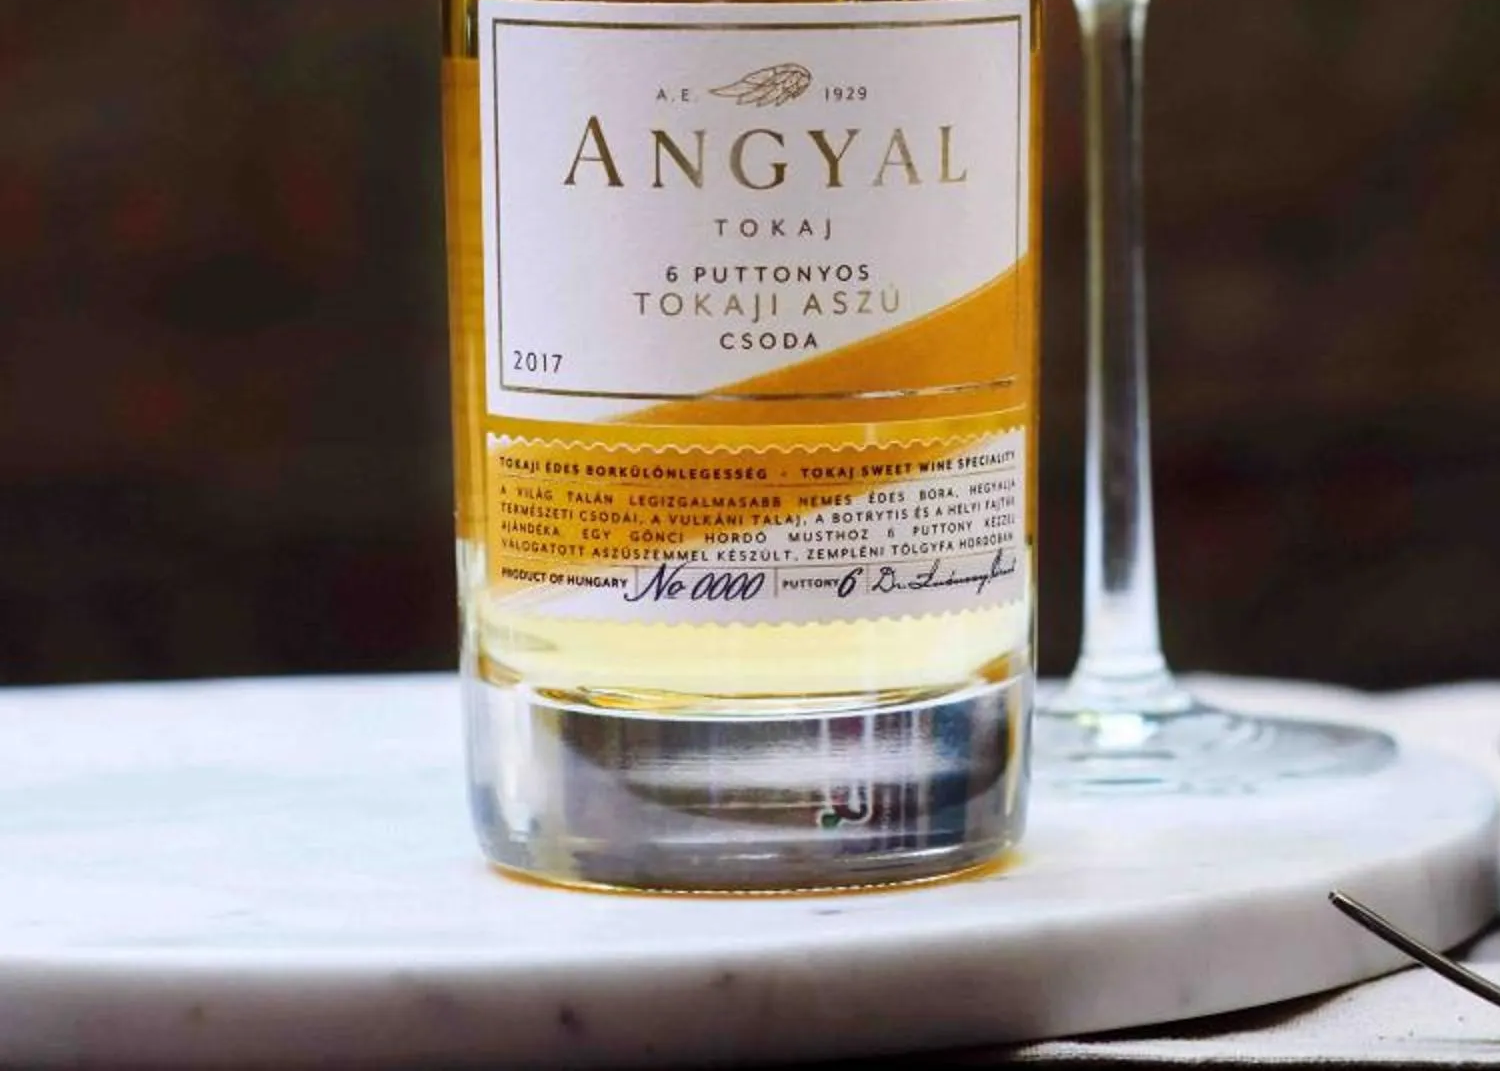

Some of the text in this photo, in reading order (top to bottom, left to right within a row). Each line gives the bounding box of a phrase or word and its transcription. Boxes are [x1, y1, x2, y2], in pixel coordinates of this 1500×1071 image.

[825, 86, 867, 101] 1929
[563, 114, 968, 189] ANGYAL
[714, 217, 832, 240] TOKAJ
[666, 263, 870, 283] 6 PUTTONYOS
[633, 282, 899, 323] TOKAJI ASZÚ
[719, 330, 818, 350] CSODA
[512, 350, 563, 373] 2017
[499, 456, 540, 473] TOKAJI
[800, 467, 854, 480] TOKAJ
[861, 463, 913, 476] SWEET
[918, 460, 953, 472] WINE
[957, 451, 1016, 469] SPECIALITY
[500, 485, 507, 495] A
[629, 495, 782, 508] LEGIZGALMASABB
[868, 490, 905, 504] ÉDES
[651, 514, 661, 524] A
[669, 512, 744, 526] VULKÁNI
[815, 514, 824, 524] A
[832, 508, 909, 524] BOTRYTIS
[935, 506, 943, 516] A
[582, 528, 612, 540] EGY
[788, 528, 870, 542] MUSTHOZ
[887, 527, 896, 539] 6
[912, 520, 973, 536] PUTTONY
[501, 567, 546, 583] PRODUCT
[549, 573, 564, 584] OF
[567, 574, 629, 589] HUNGARY
[783, 577, 838, 591] PUTTONY
[838, 567, 864, 599] 6
